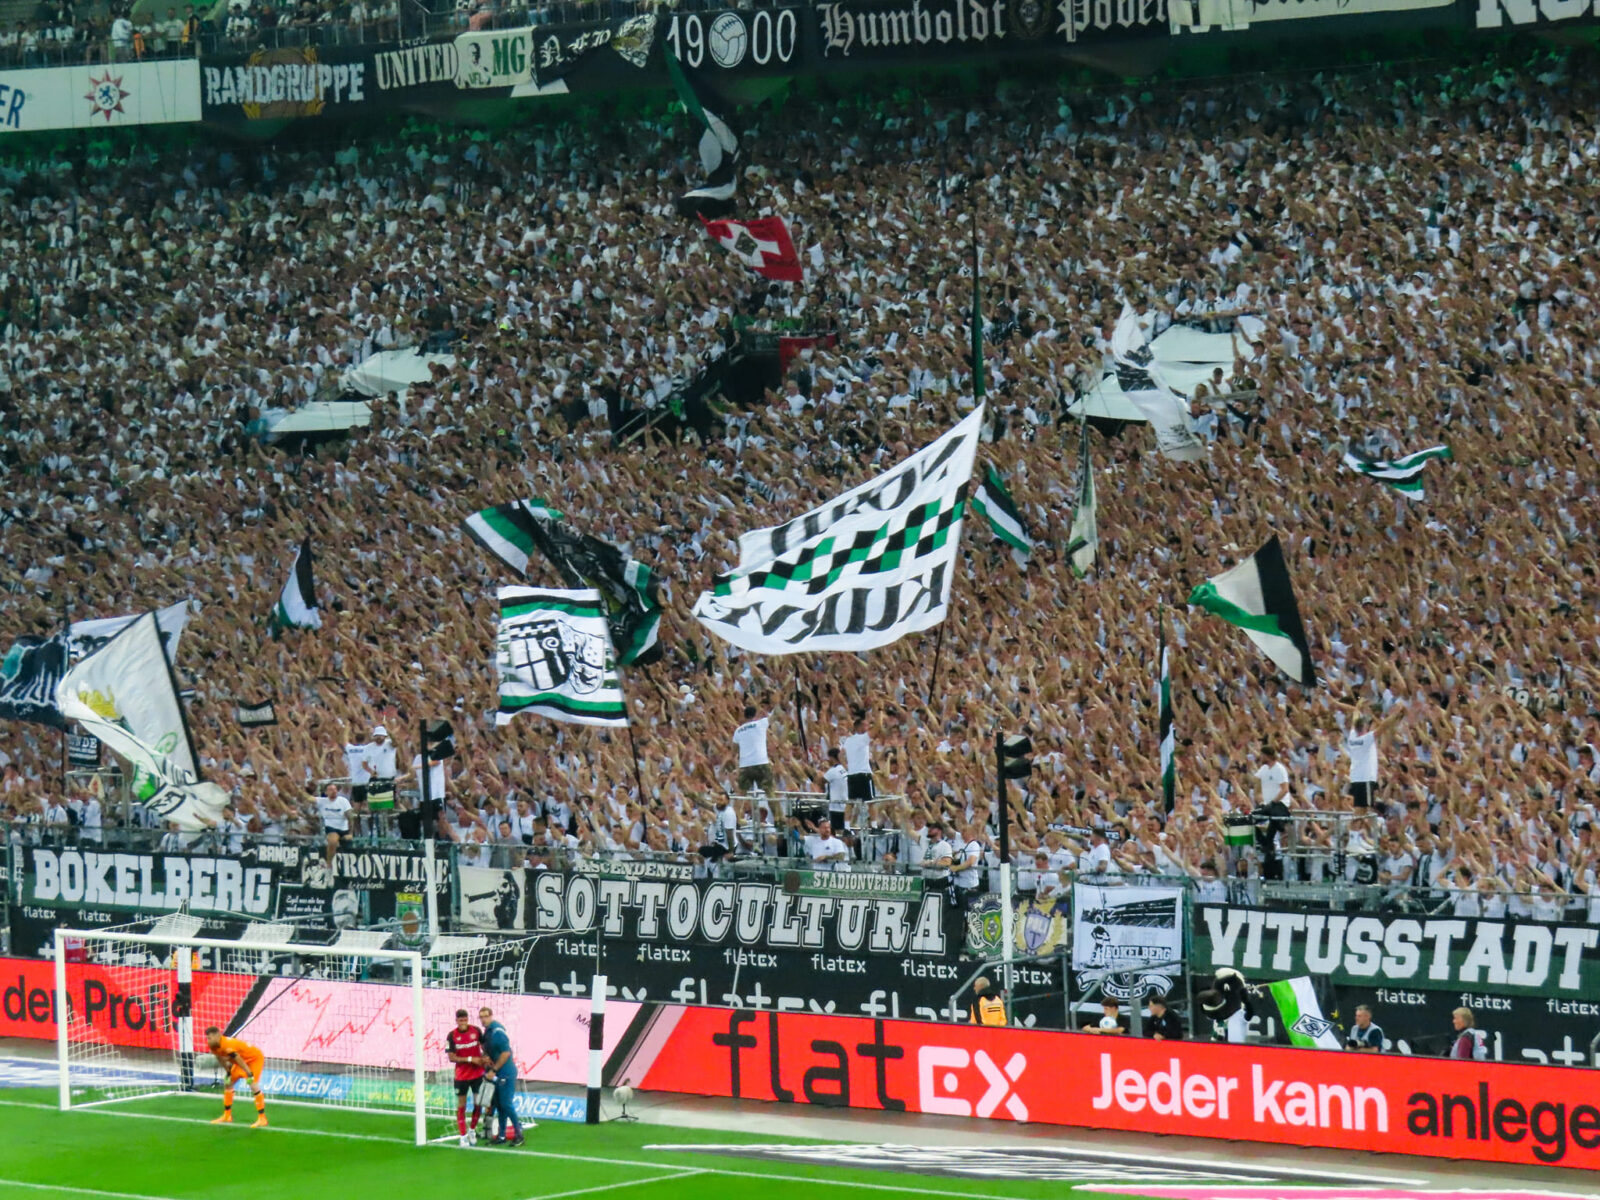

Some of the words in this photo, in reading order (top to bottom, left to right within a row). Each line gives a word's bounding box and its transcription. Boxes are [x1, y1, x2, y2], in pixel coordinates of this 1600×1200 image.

[816, 0, 1006, 57] Humboldt
[204, 63, 365, 105] RANDGRUPPE
[374, 42, 458, 90] UNITED
[492, 35, 526, 76] MG
[32, 846, 272, 914] BÖKELBERG
[813, 870, 914, 892] STADIONVERBOT
[535, 872, 946, 956] SOTTOCULTURA
[1203, 907, 1599, 990] VITUSSTADT
[1092, 1052, 1238, 1120] Jeder
[1252, 1063, 1389, 1133] kann
[1407, 1081, 1600, 1164] anlege
